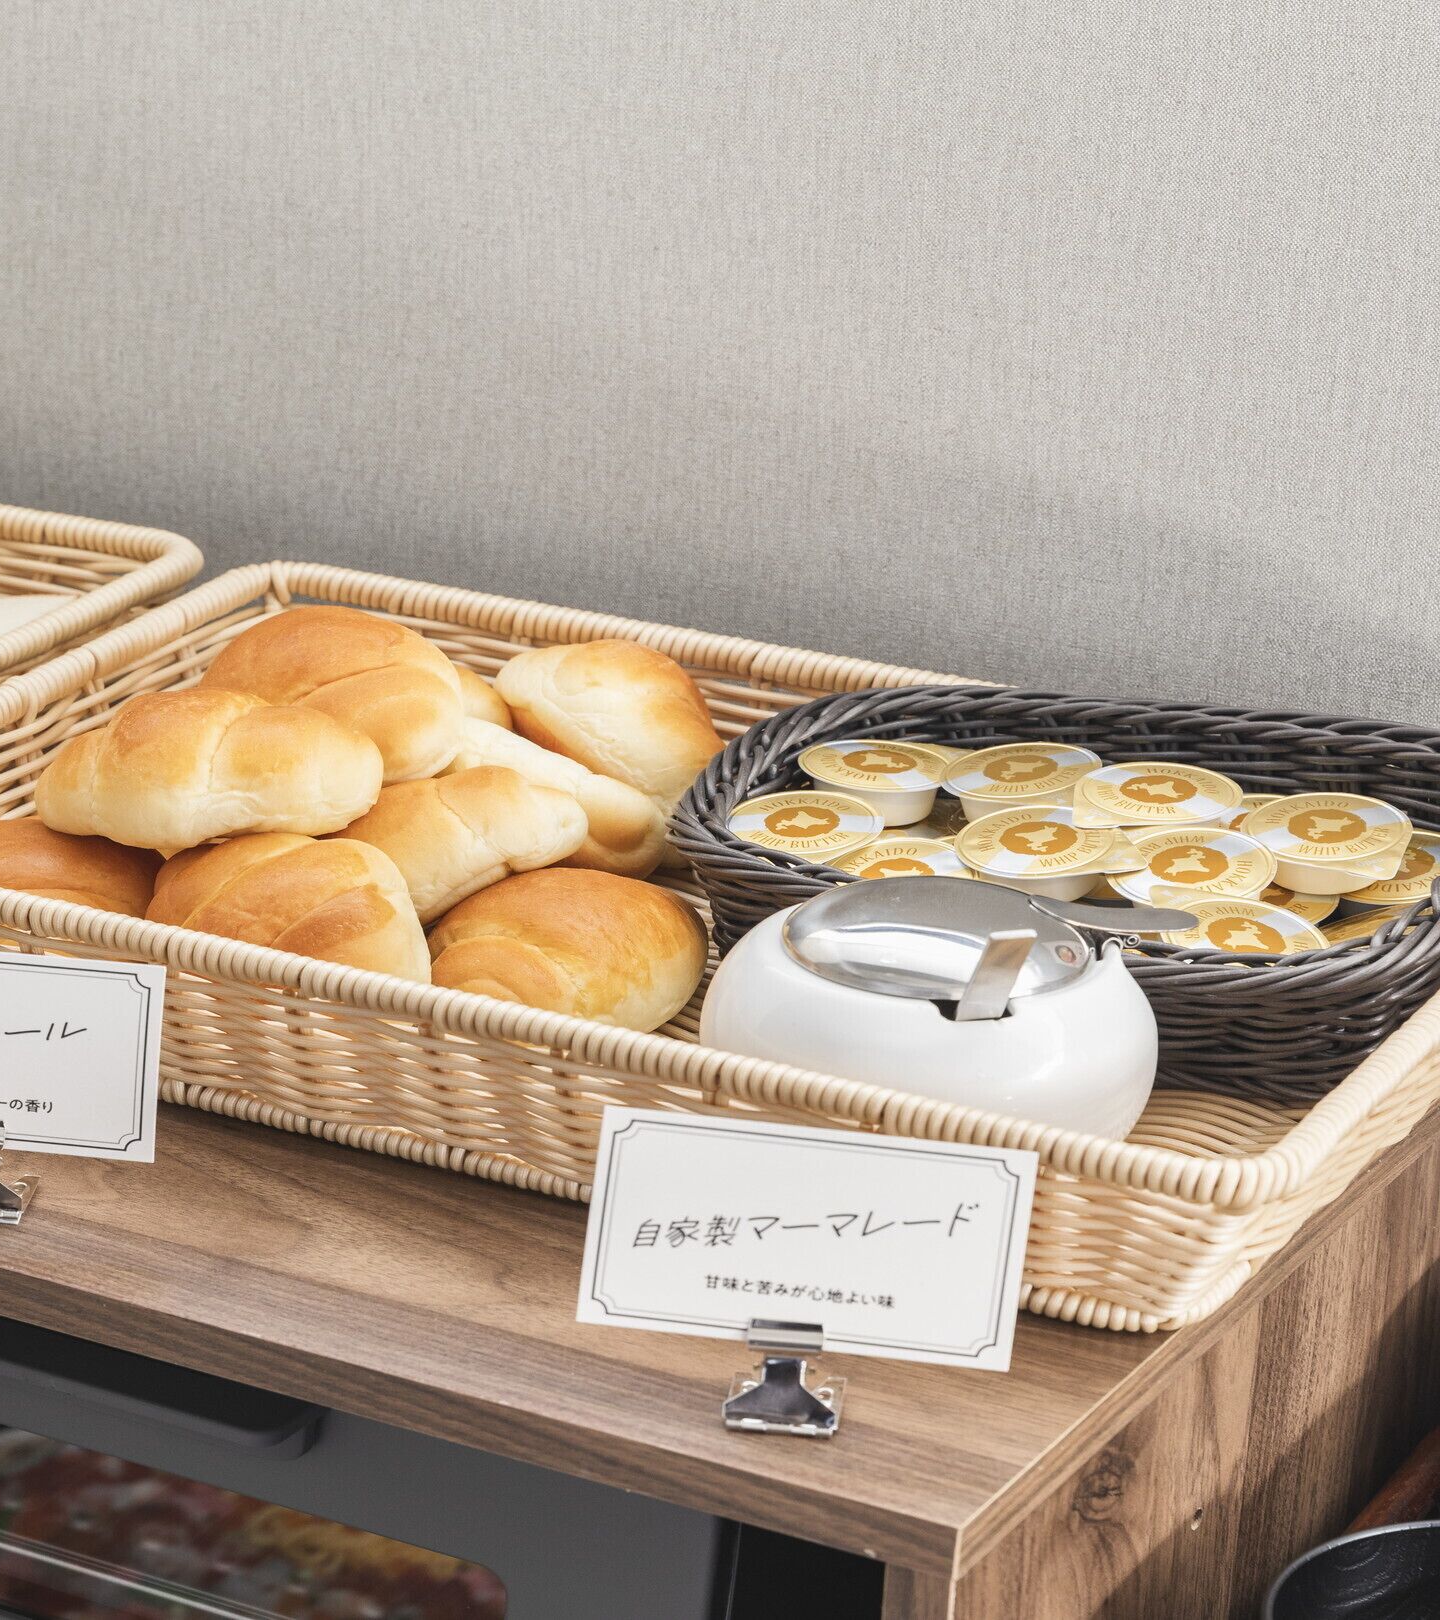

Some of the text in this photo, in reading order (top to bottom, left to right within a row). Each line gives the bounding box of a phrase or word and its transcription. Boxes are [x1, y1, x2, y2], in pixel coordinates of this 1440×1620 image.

[989, 783, 1029, 793] WHIP
[759, 797, 851, 813] HOKKAIDO
[1114, 798, 1176, 814] BUTTER
[1265, 800, 1350, 825] HOKKAIDO
[749, 831, 850, 848] WHIP BUTTER
[977, 813, 1033, 852] HOKKAIDO
[1164, 835, 1206, 846] WHIP
[1297, 844, 1341, 855] WHIP
[1345, 826, 1390, 854] BUTTER
[1039, 851, 1078, 868] WHIP
[1215, 905, 1256, 917] WHIP
[633, 1202, 980, 1249] 自家製マーマレード
[704, 1274, 896, 1309] 甘味と苦みが心地よい味
